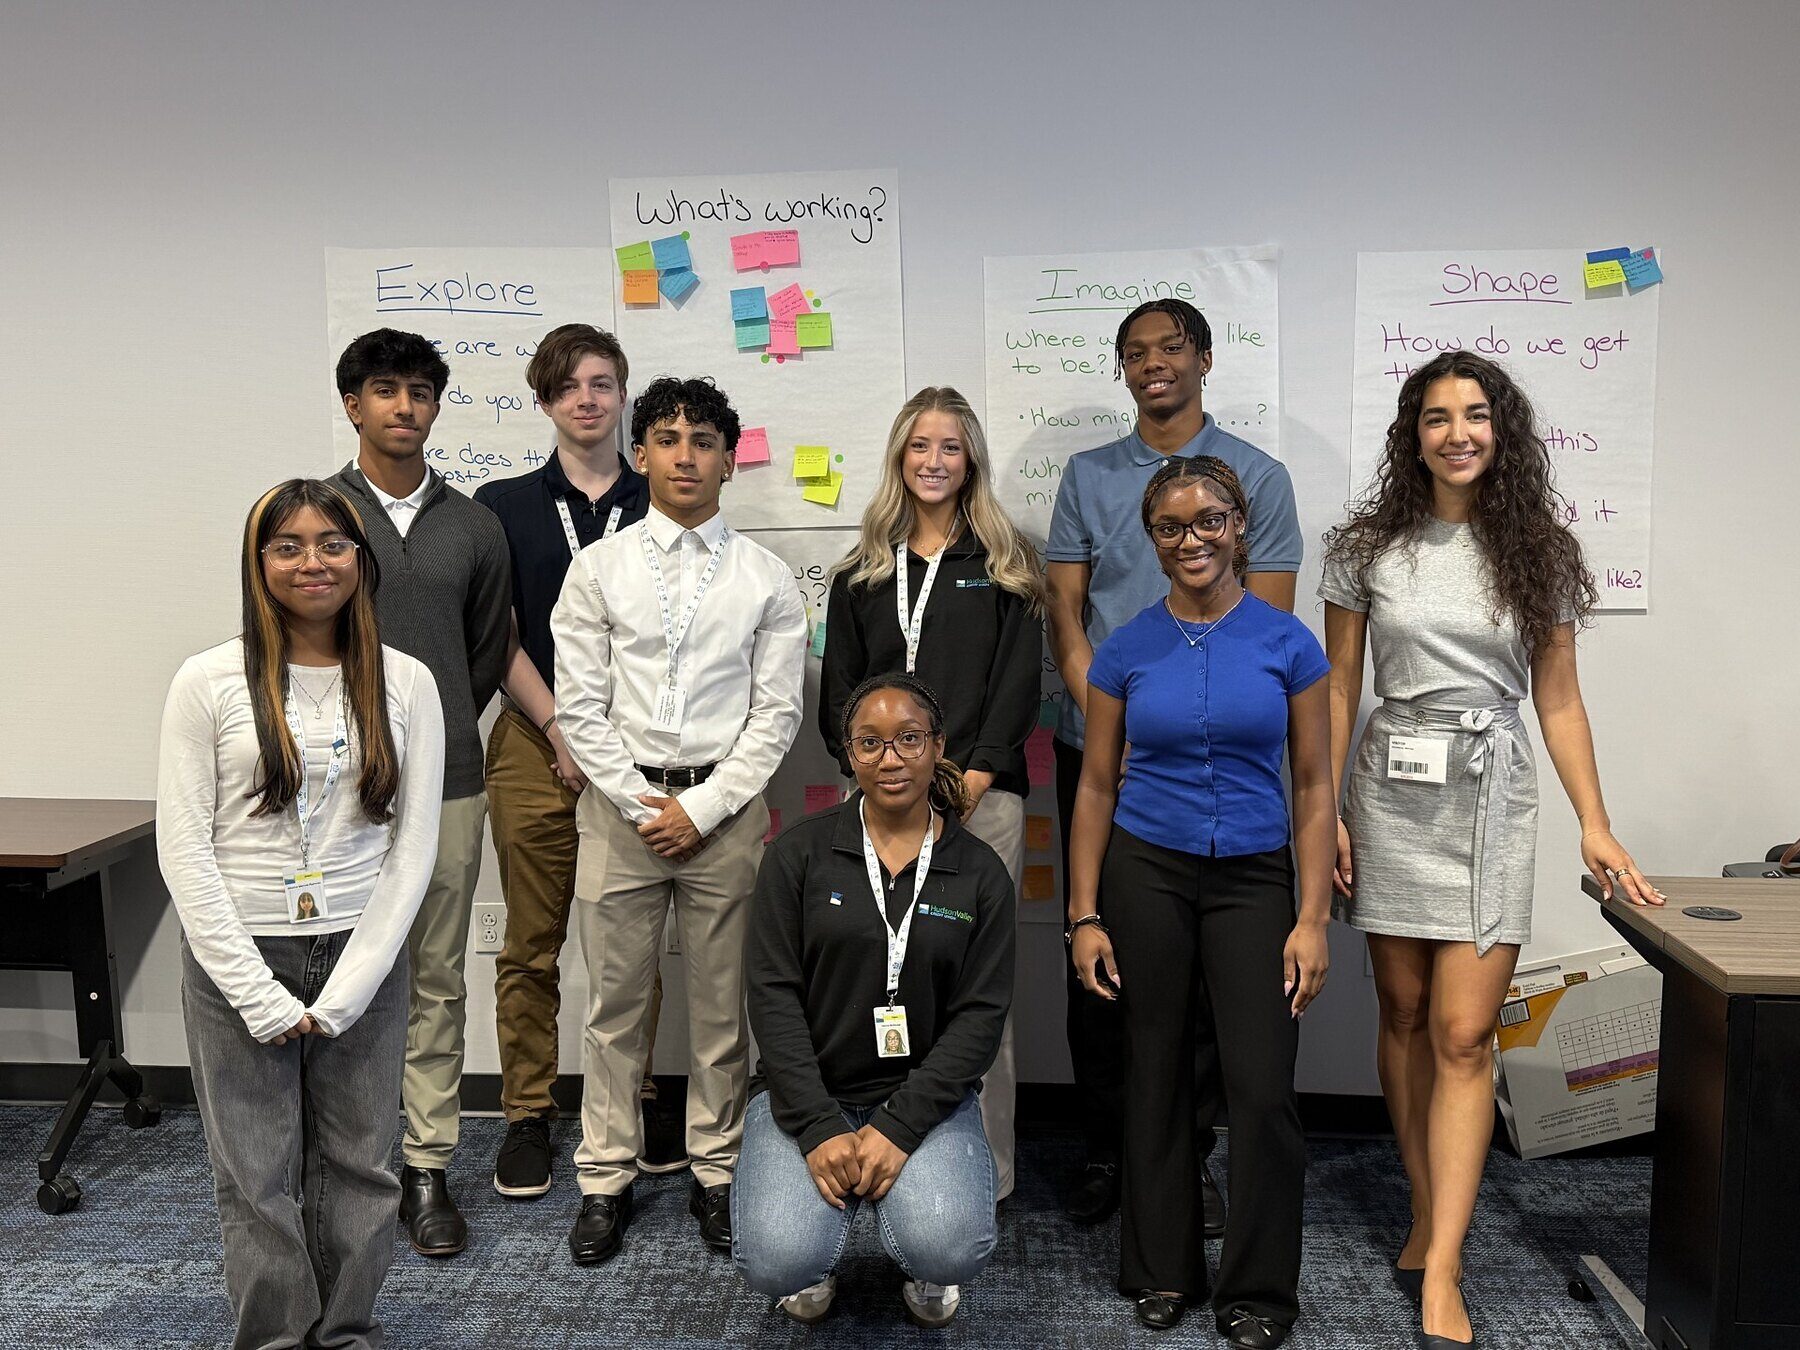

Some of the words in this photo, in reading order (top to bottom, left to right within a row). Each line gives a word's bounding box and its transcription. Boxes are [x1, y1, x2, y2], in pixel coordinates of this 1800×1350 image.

[636, 188, 751, 225] What's
[765, 187, 887, 243] working?
[376, 264, 537, 314] Explore
[1036, 269, 1196, 314] Imagine
[1442, 263, 1560, 301] Shape
[1005, 328, 1086, 350] Where
[1227, 321, 1266, 347] like
[1381, 322, 1462, 353] How
[1475, 325, 1510, 354] do
[1527, 336, 1567, 354] we
[1580, 330, 1630, 369] get
[455, 341, 501, 357] are
[1012, 357, 1042, 374] to
[1061, 353, 1107, 374] be?
[447, 385, 473, 405] do
[486, 394, 523, 424] you
[1030, 406, 1080, 427] How
[1544, 425, 1599, 452] this
[458, 443, 512, 467] does
[1594, 499, 1619, 523] it
[1607, 568, 1643, 589] like?
